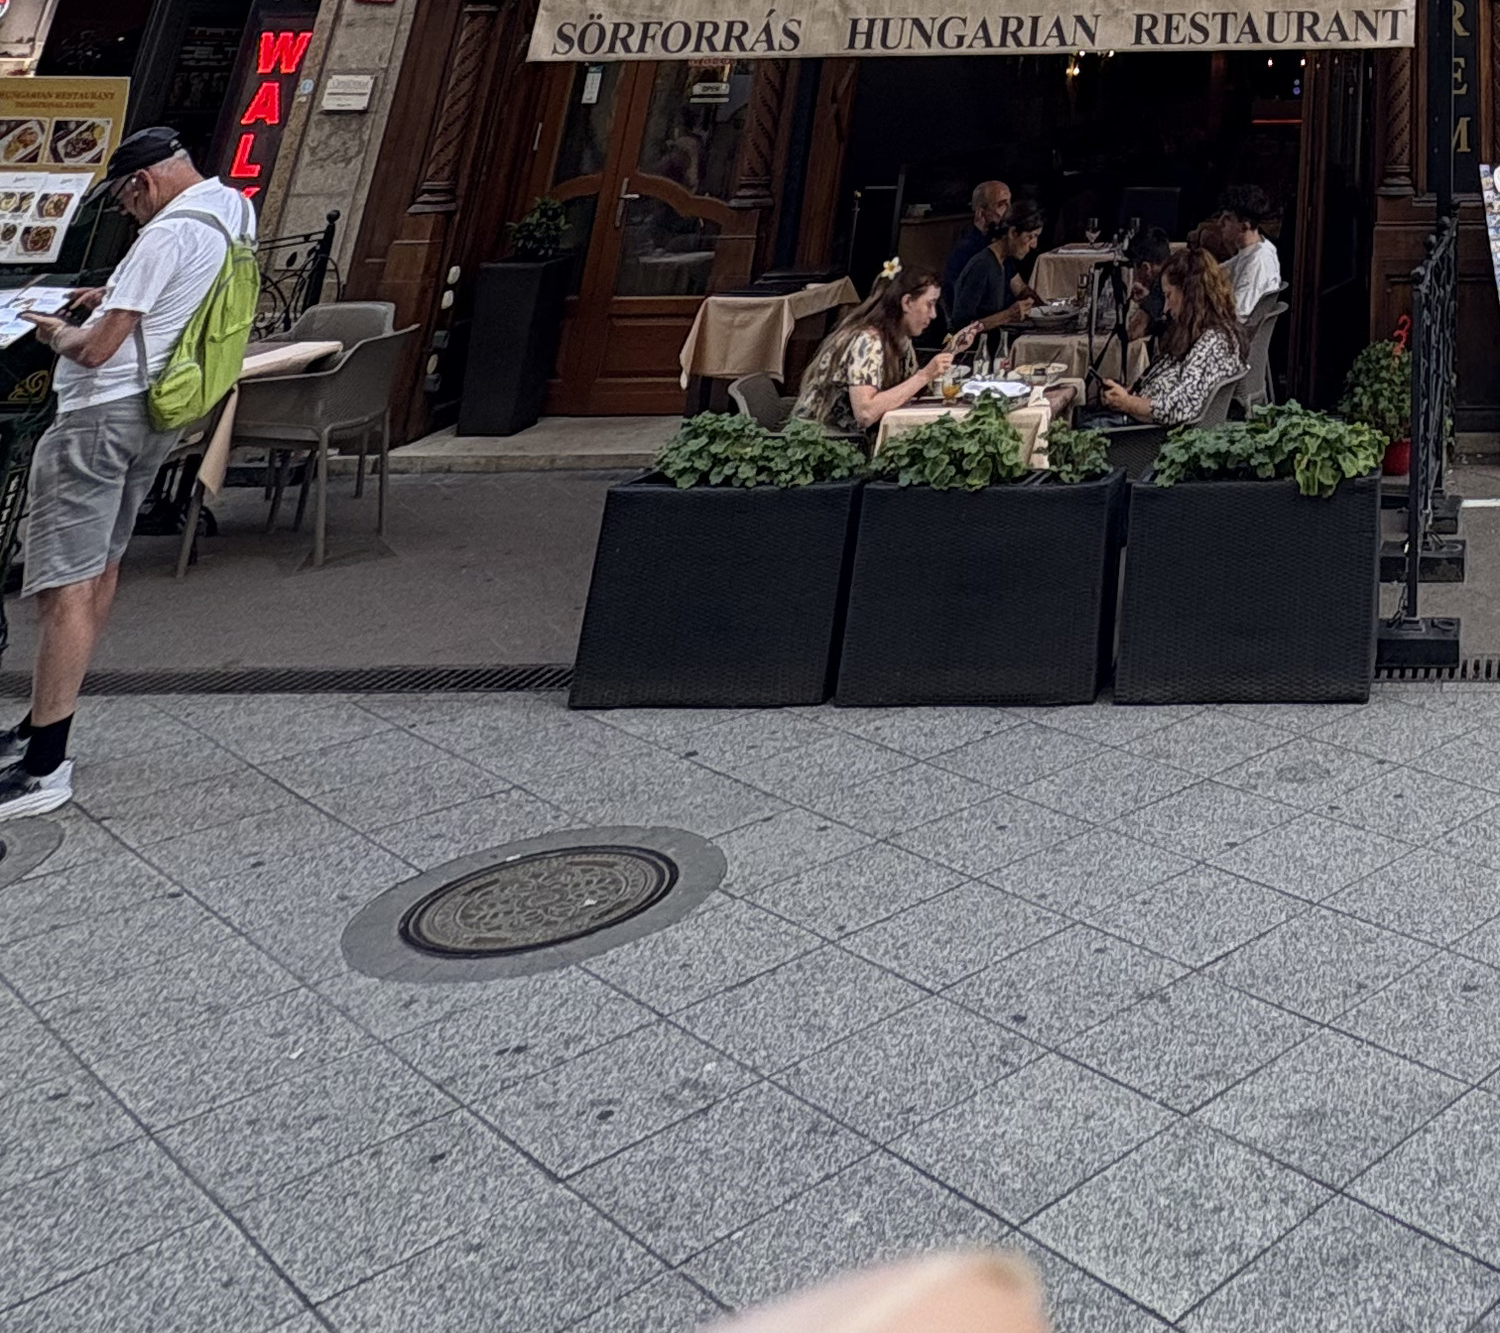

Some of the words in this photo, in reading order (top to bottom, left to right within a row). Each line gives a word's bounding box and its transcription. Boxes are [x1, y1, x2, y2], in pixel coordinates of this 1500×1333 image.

[552, 9, 802, 55] SÖRFORRÁS
[845, 13, 1102, 50] HUNGARIAN
[1130, 8, 1408, 46] RESTAURANT
[229, 31, 313, 199] WAL
